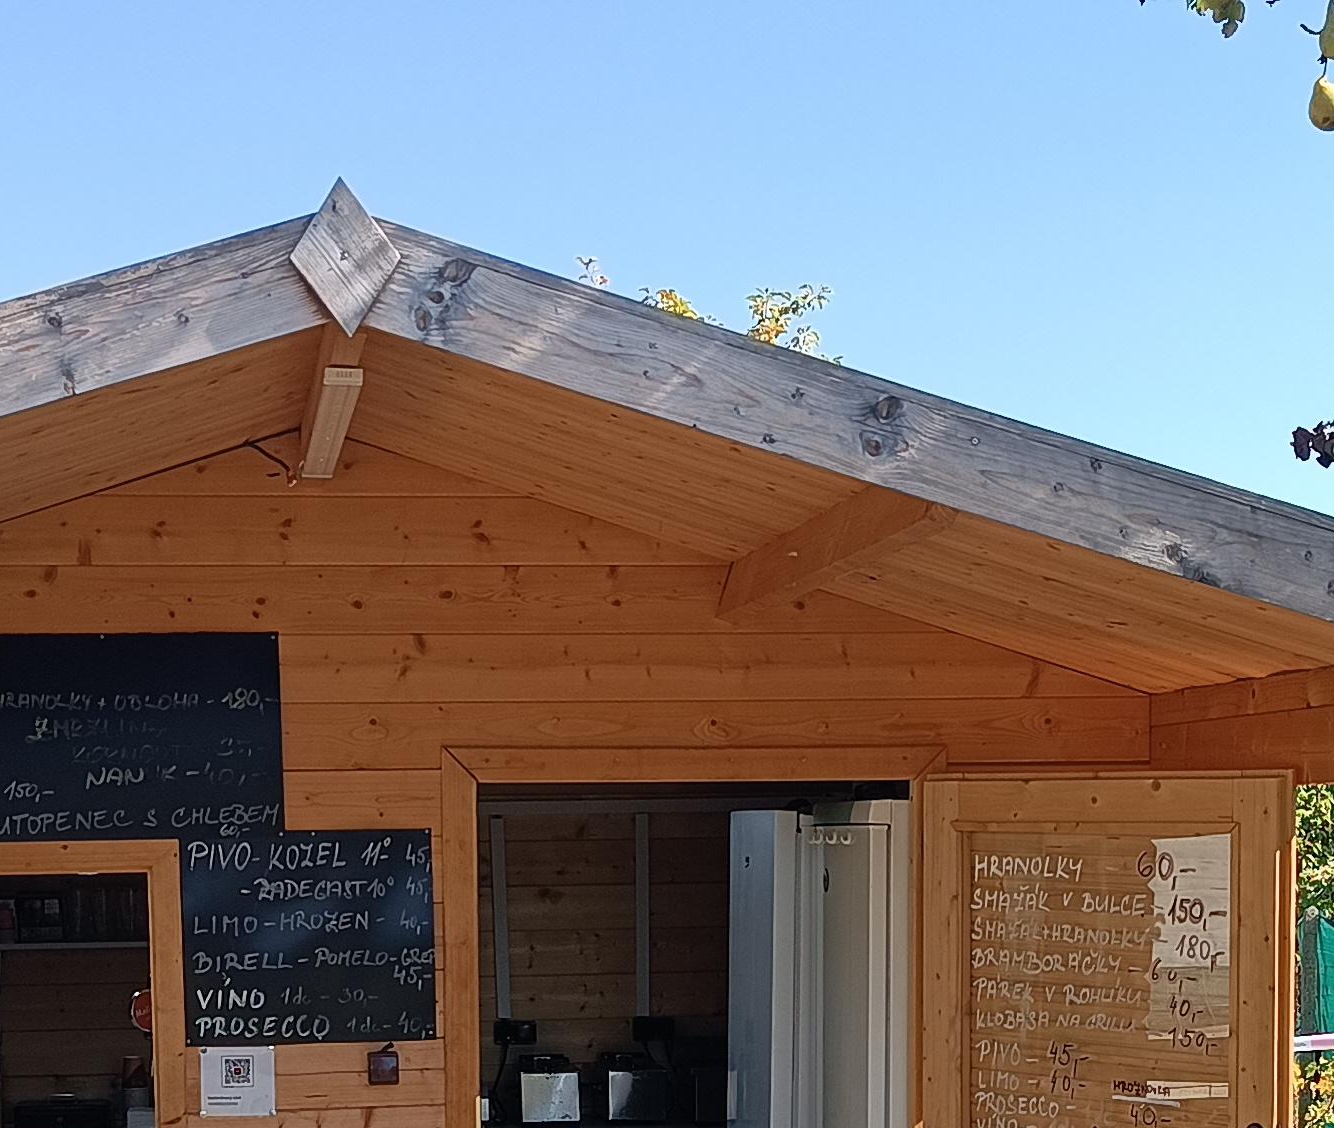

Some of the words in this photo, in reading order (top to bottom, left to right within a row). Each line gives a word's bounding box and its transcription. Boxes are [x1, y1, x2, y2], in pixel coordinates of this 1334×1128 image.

[114, 692, 199, 711] OBLOHA
[4, 781, 55, 803] 150,-
[143, 808, 158, 827] S
[171, 802, 280, 828] CHLEBEM
[268, 841, 347, 871] KOZEL
[974, 855, 1083, 882] HRANOLKY
[254, 878, 367, 901] RADEGAST
[970, 883, 1050, 913] SMAŽÁK
[1081, 893, 1147, 916] BULCE
[193, 951, 293, 974] BIRELL
[971, 947, 1121, 975] BRAMBORÁČKY
[196, 972, 265, 1010] VÍNO
[973, 972, 1034, 1003] PÁREK
[1063, 976, 1143, 1007] ROHLÍKU
[1170, 995, 1204, 1023] 40,-
[195, 1015, 330, 1040] PROSECCO
[1055, 1013, 1080, 1029] NA
[975, 1039, 1020, 1069] PIVO
[977, 1070, 1020, 1091] LIMO
[975, 1093, 1059, 1118] PROSECCO
